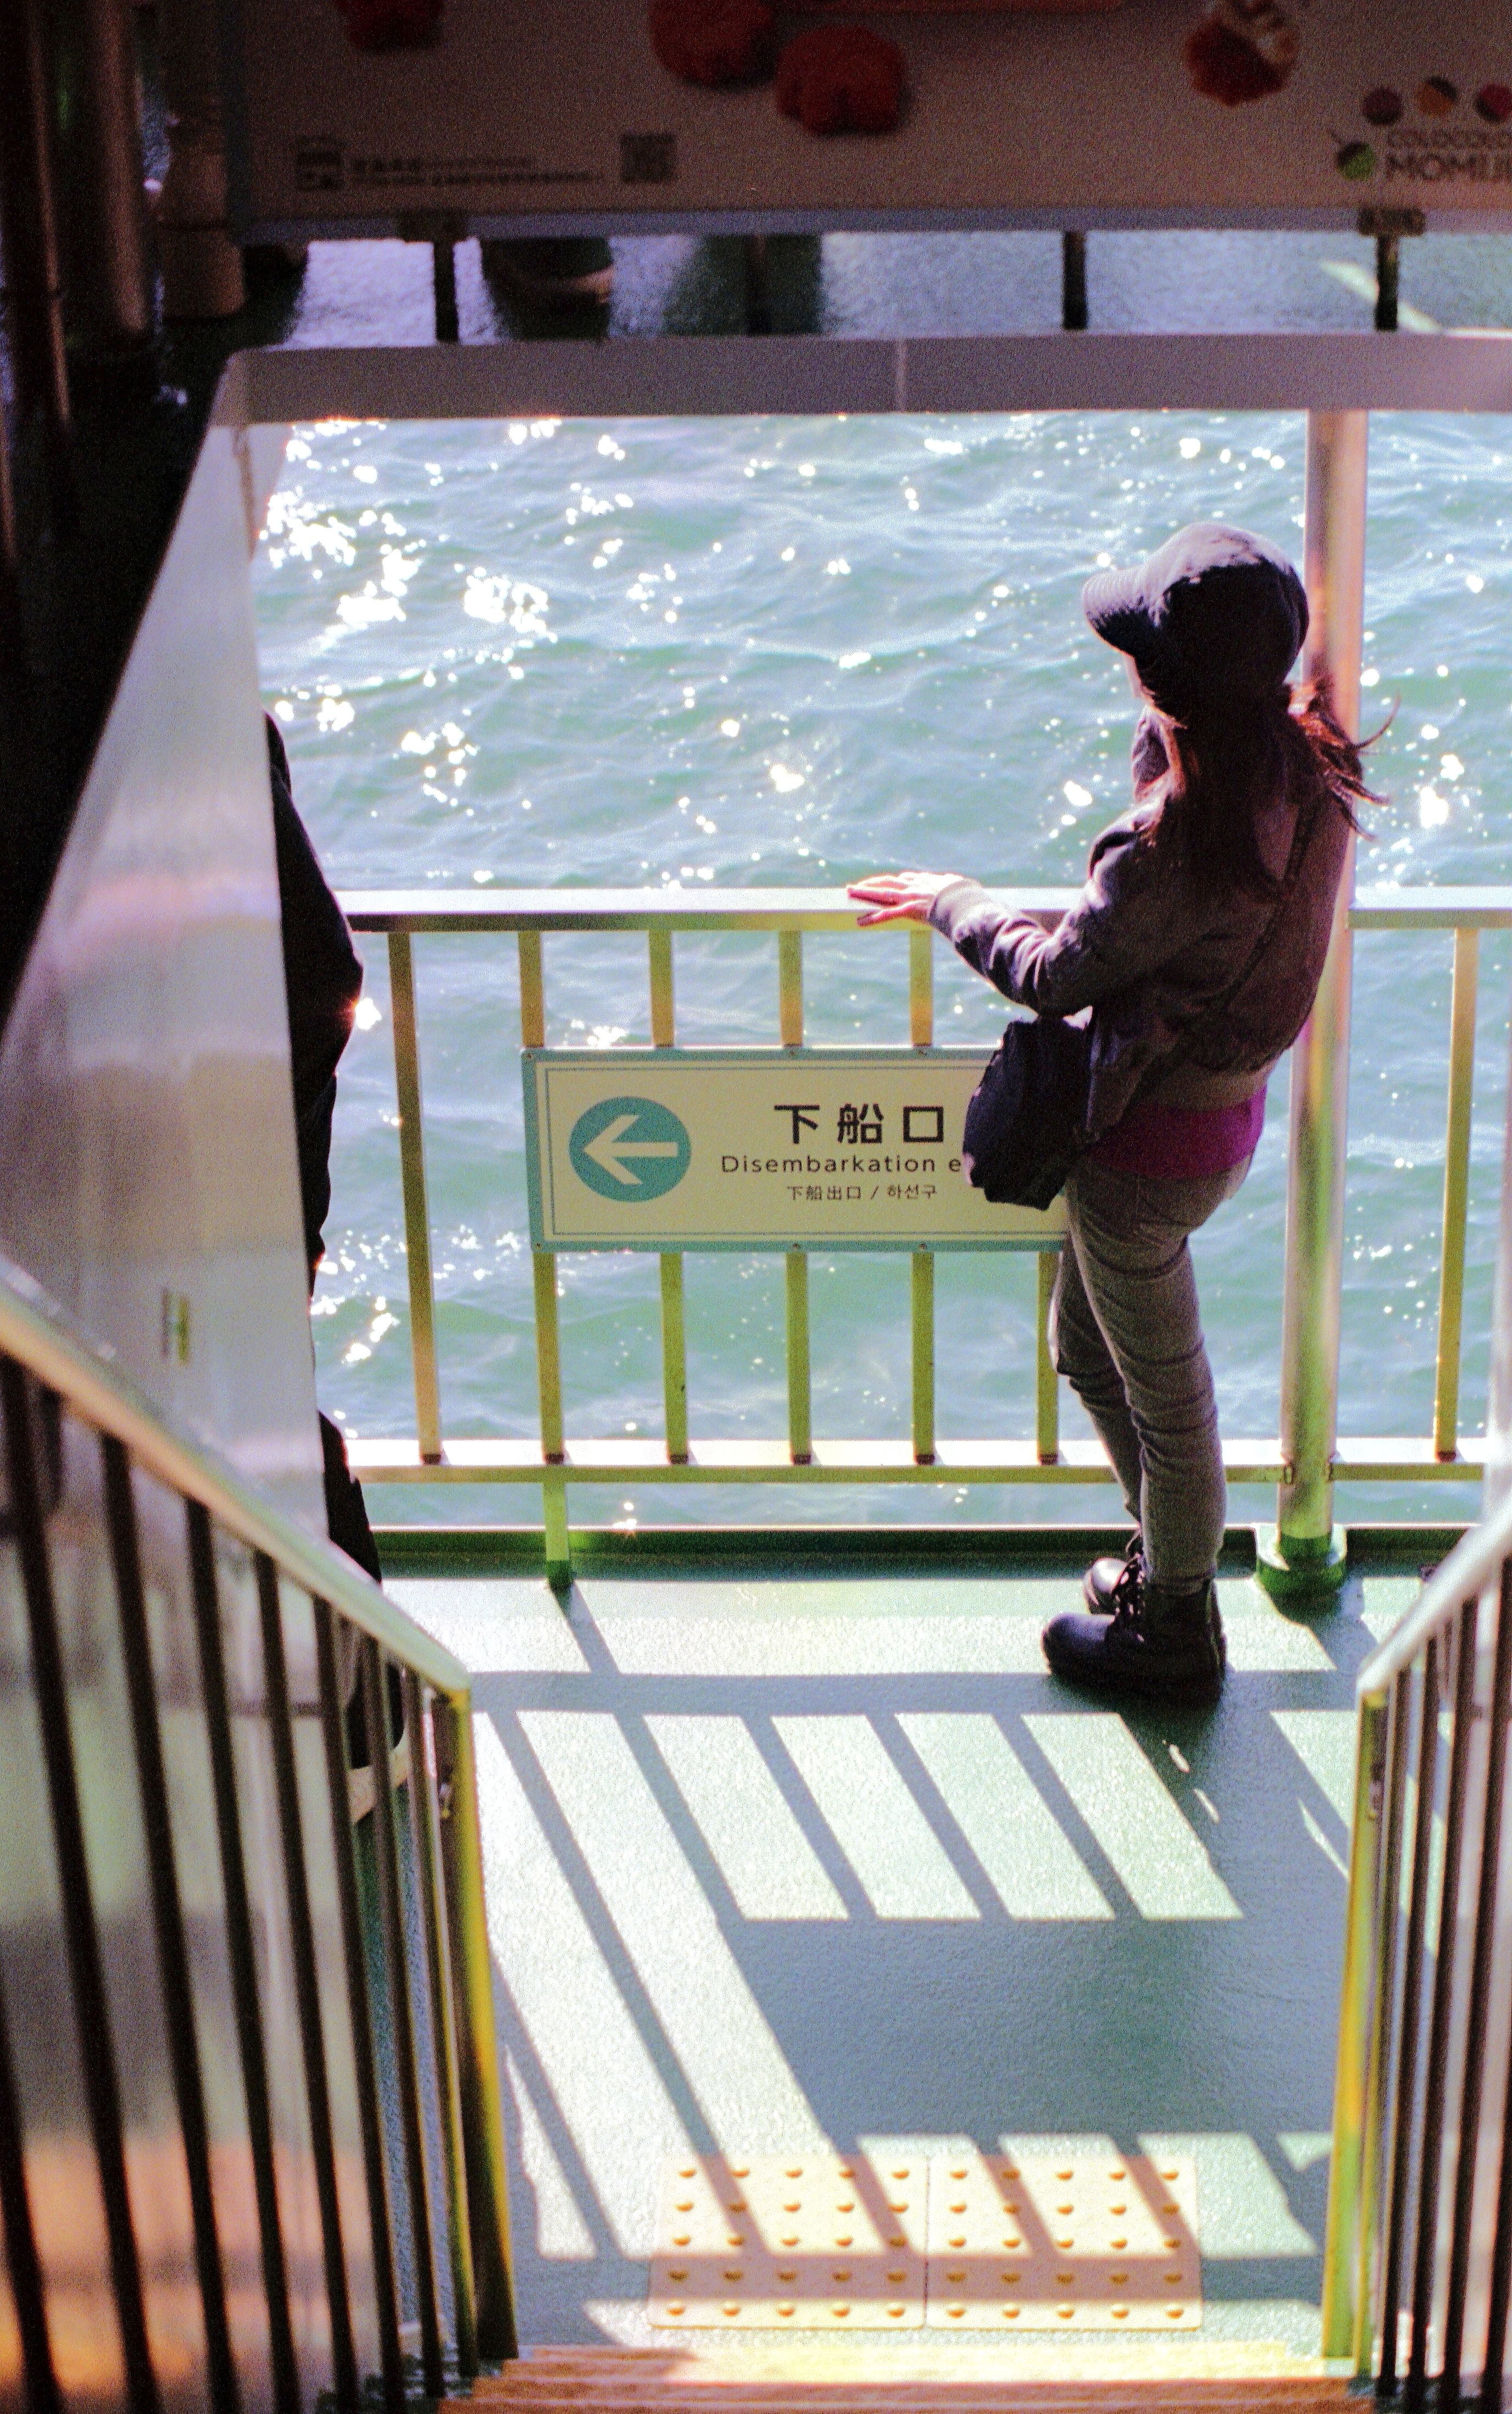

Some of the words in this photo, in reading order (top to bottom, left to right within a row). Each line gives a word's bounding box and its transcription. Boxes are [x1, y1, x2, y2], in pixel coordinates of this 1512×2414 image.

[774, 1103, 944, 1145] 下船口
[721, 1154, 936, 1173] Disembarkation
[786, 1184, 862, 1202] 下船出口
